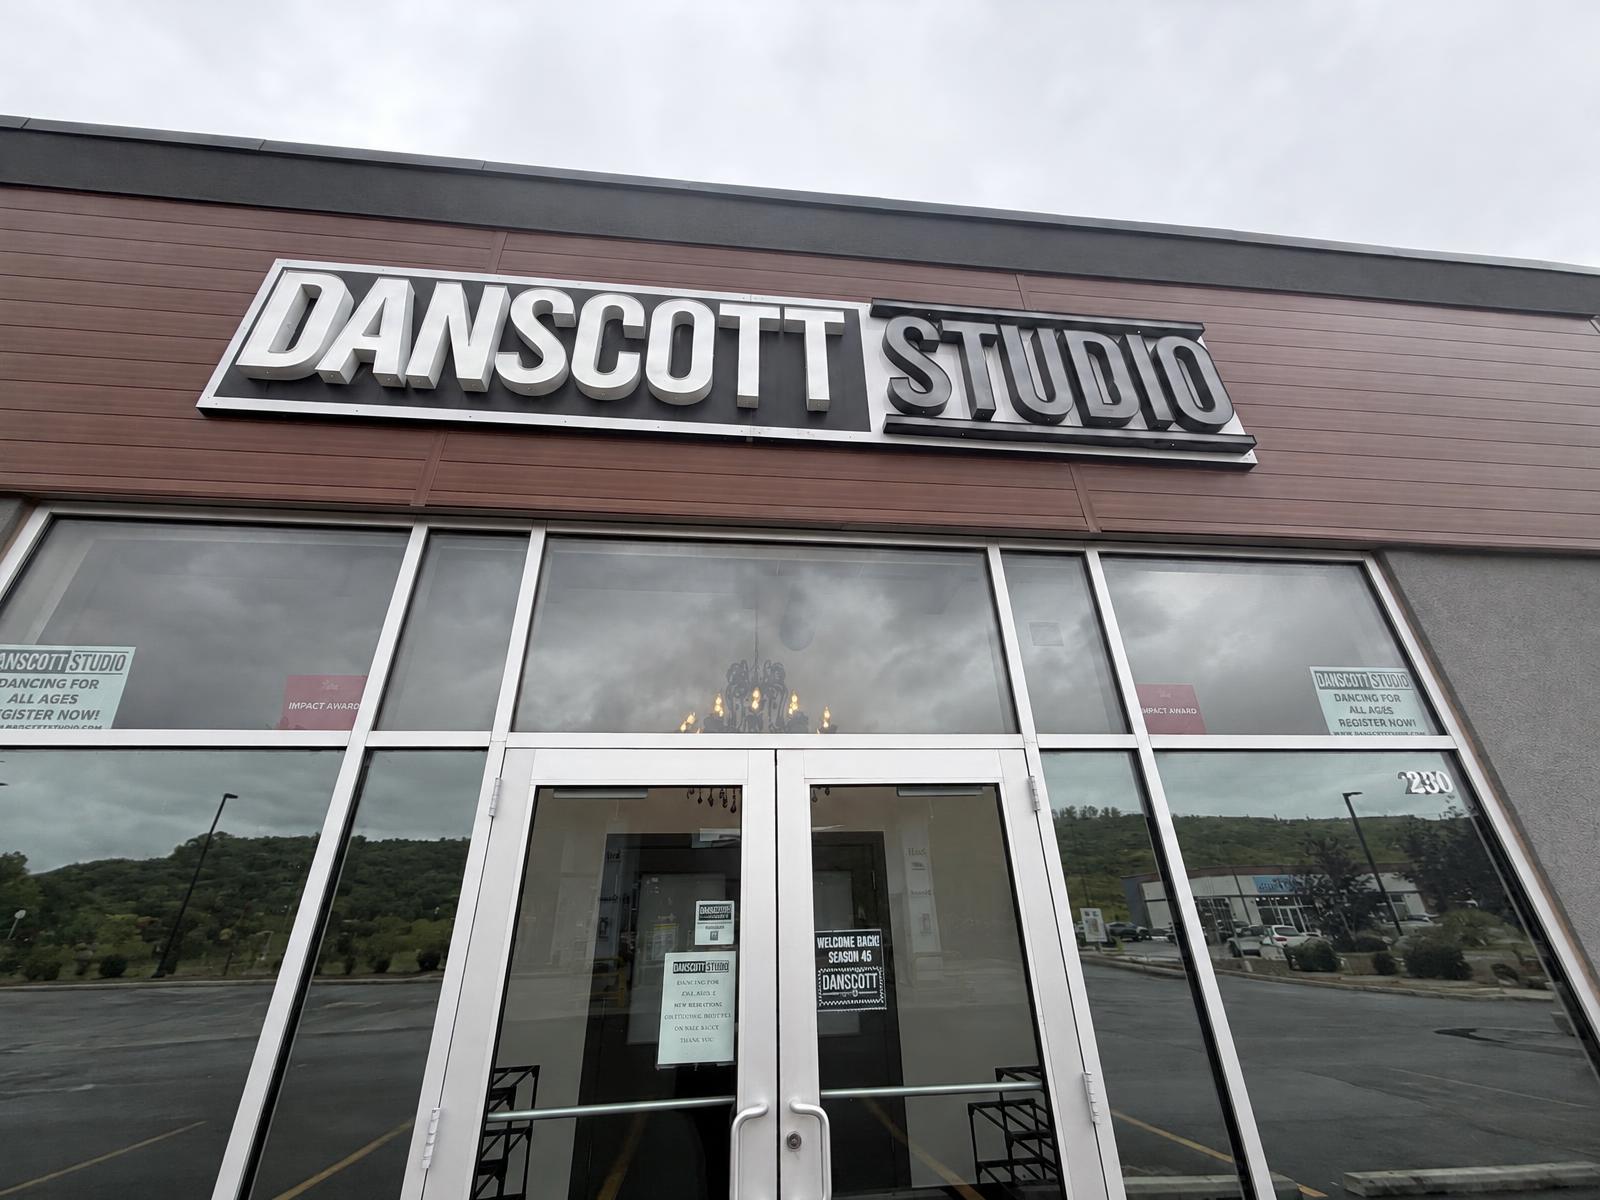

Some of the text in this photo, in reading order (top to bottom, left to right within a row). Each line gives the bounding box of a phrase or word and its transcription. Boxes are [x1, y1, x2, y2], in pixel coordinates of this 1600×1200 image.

[235, 270, 1235, 433] DANSCOTT STUDIO
[69, 654, 127, 672] STUDIO
[0, 678, 100, 690] DANCING FOR
[1316, 672, 1410, 688] DANSCOTT STUDIO
[7, 693, 79, 704] ALL AGES
[1334, 694, 1401, 703] DANCING FOR
[289, 702, 360, 710] IMPACT AWARD
[1349, 706, 1394, 714] ALL AGES
[0, 709, 101, 721] GISTER NOW!
[1338, 718, 1417, 727] REGISTER NOW!
[817, 935, 880, 948] WELCOME BACK!
[828, 950, 872, 963] SEASON 45
[822, 973, 878, 990] DANSCOTT
